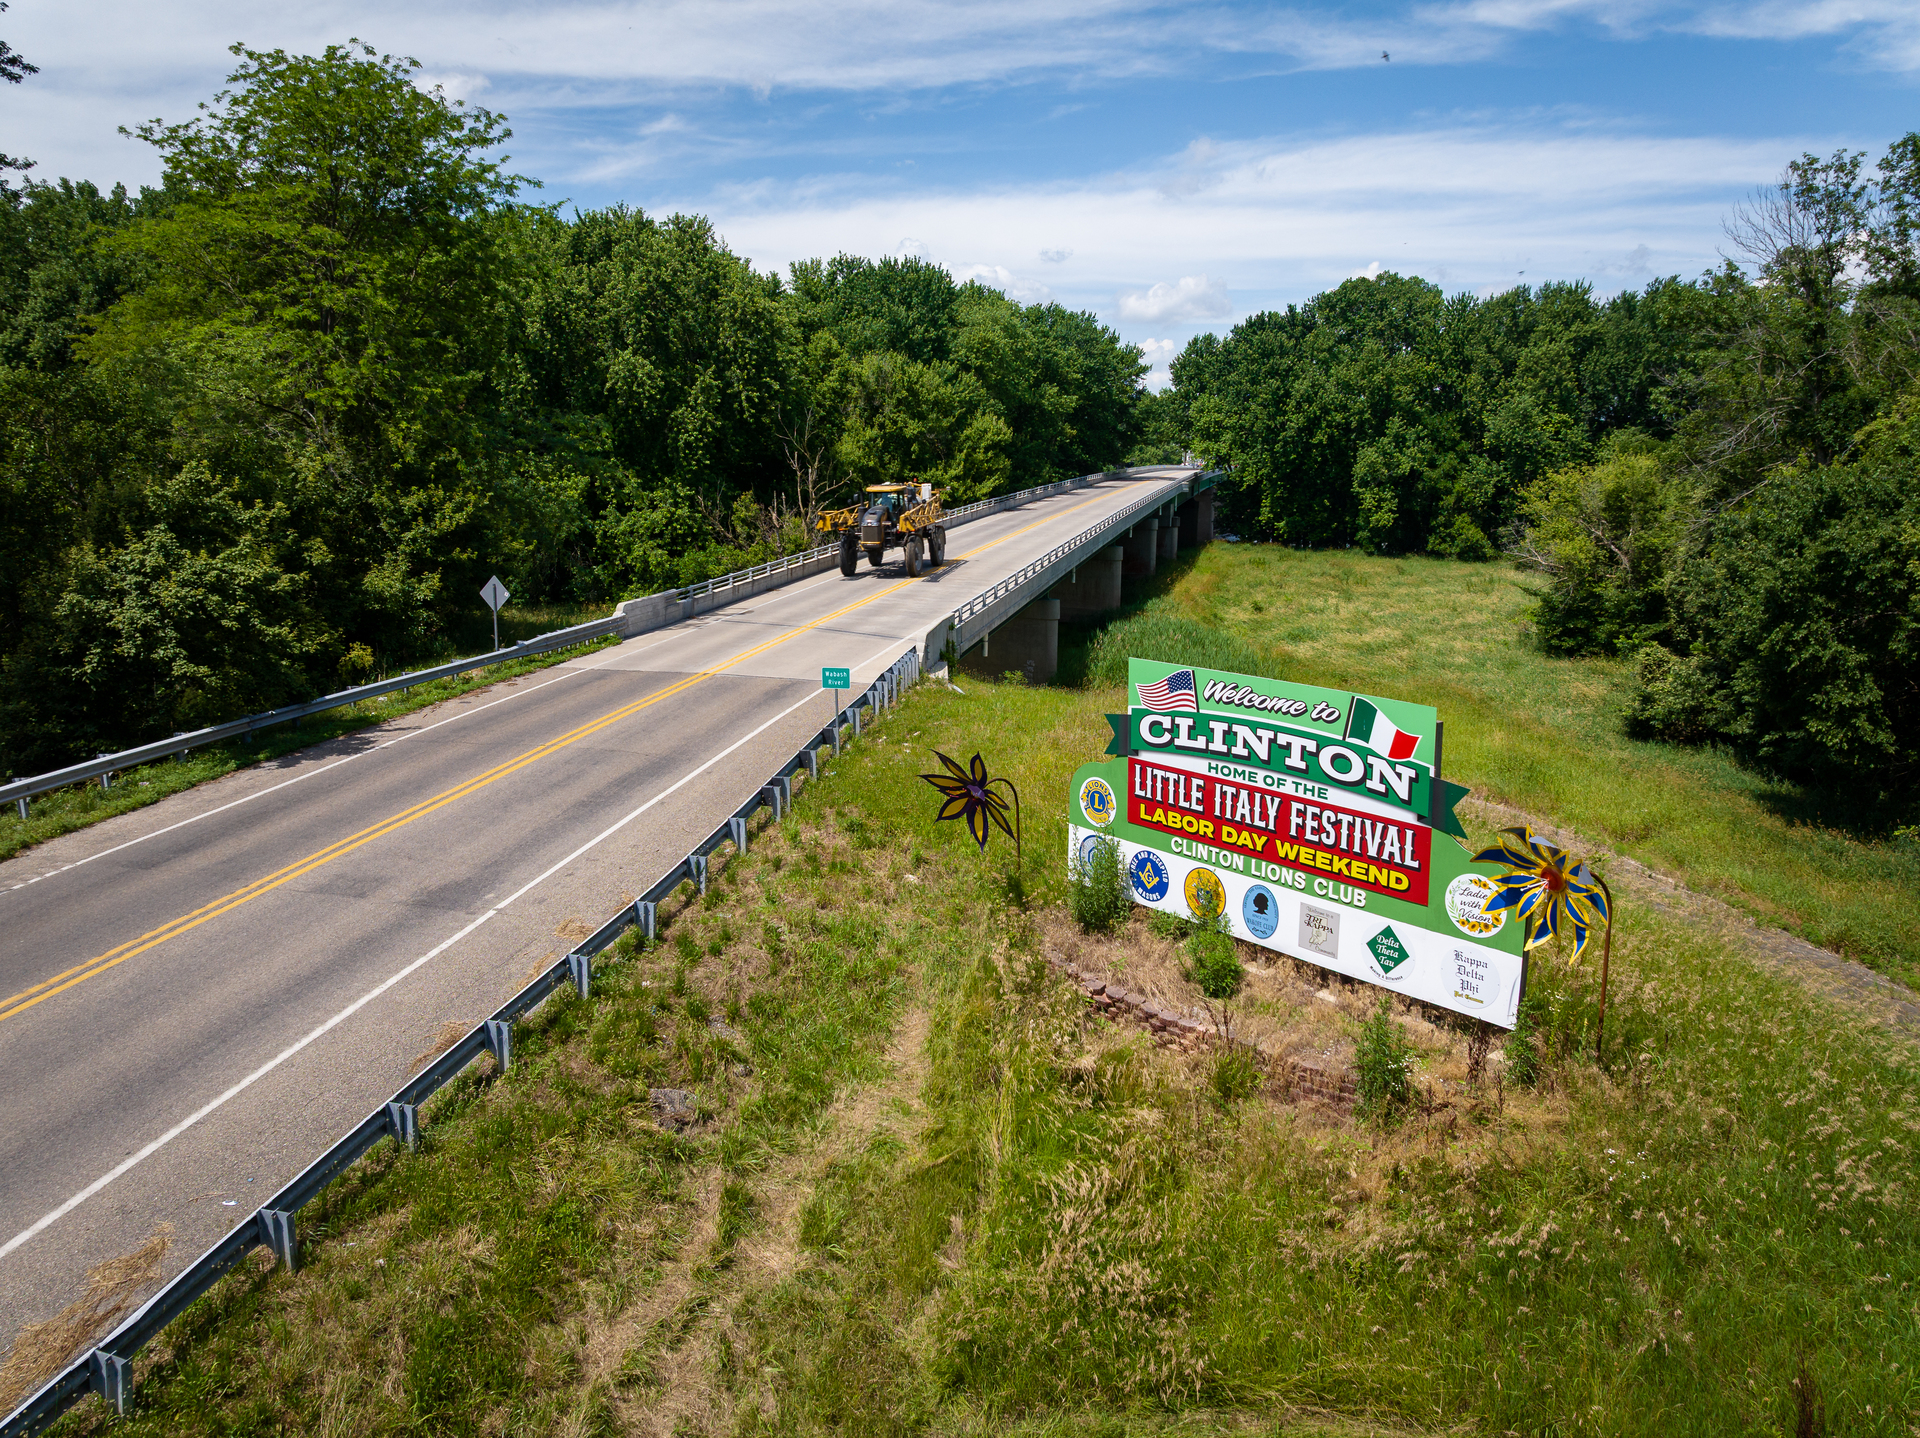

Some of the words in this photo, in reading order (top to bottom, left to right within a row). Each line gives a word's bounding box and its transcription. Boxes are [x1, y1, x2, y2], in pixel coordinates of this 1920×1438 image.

[1203, 679, 1307, 717] Welcome
[1310, 701, 1341, 723] to
[1139, 714, 1418, 804] CLINTON
[1088, 781, 1107, 794] LIONS
[1208, 762, 1258, 784] HOME
[1263, 774, 1287, 789] OF
[1292, 781, 1329, 800] THE
[1134, 764, 1205, 813] LITTLE
[1214, 783, 1282, 832] ITALY
[1289, 801, 1420, 870] FESTIVAL
[1140, 803, 1215, 839] LABOR
[1221, 825, 1268, 852] DAY
[1275, 839, 1411, 891] WEEKEND
[1137, 851, 1148, 860] AND
[1149, 853, 1168, 883] ACCEPTED
[1171, 837, 1244, 872] CLINTON
[1251, 859, 1306, 890] LIONS
[1314, 878, 1367, 908] CLUB
[1137, 887, 1161, 901] MASONS
[1460, 886, 1488, 900] Ladie
[1460, 899, 1482, 910] with
[1305, 913, 1323, 924] TRI
[1459, 908, 1491, 923] Vision
[1304, 920, 1334, 935] KAPPA
[1376, 935, 1400, 949] Delta
[1376, 945, 1399, 958] Theta
[1453, 949, 1488, 969] Kappa
[1379, 956, 1395, 968] Tau
[1456, 964, 1484, 982] Delta
[1460, 978, 1479, 995] Phi
